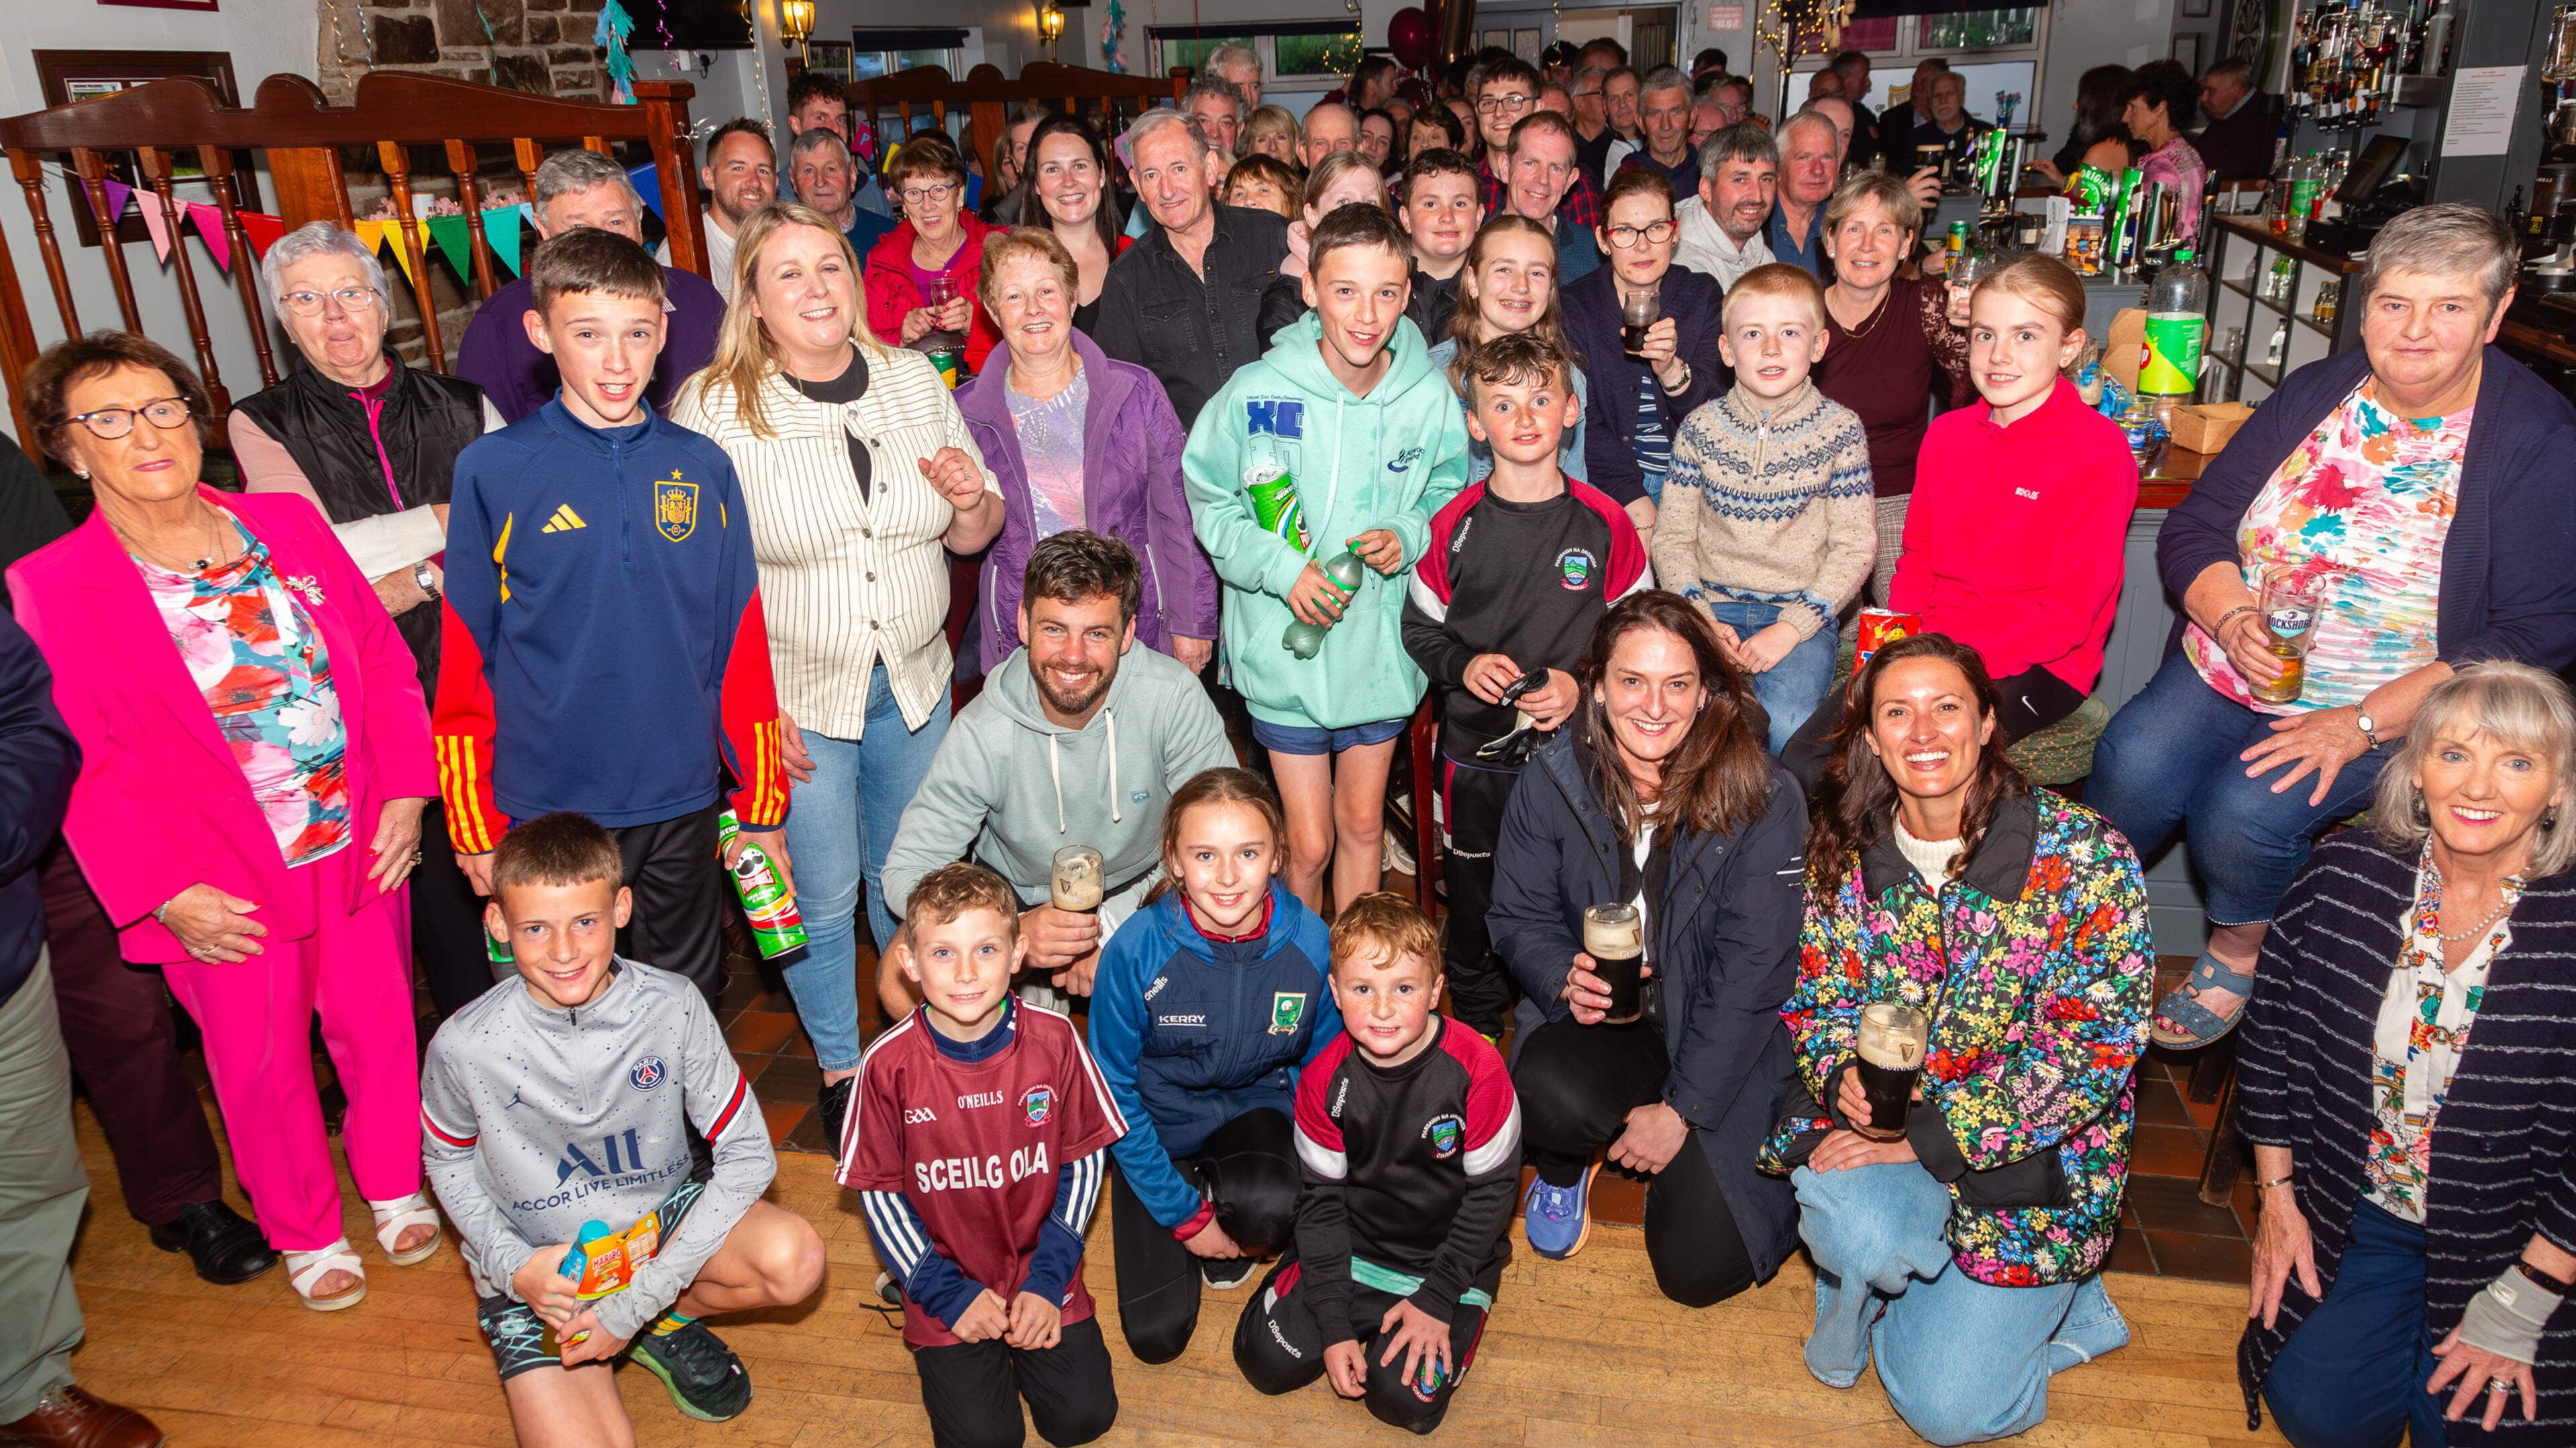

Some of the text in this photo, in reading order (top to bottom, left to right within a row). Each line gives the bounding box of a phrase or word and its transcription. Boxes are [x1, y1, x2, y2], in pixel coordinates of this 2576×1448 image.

[2267, 614, 2314, 630] ROCKSHORE
[1159, 1015, 1206, 1023] KERRY
[957, 1091, 1004, 1109] O'NEILLS
[915, 1141, 1049, 1194] SCEILG OLA
[512, 1154, 690, 1211] ACCOR LIVE LIMITLESS
[592, 1247, 623, 1270] HARIBO
